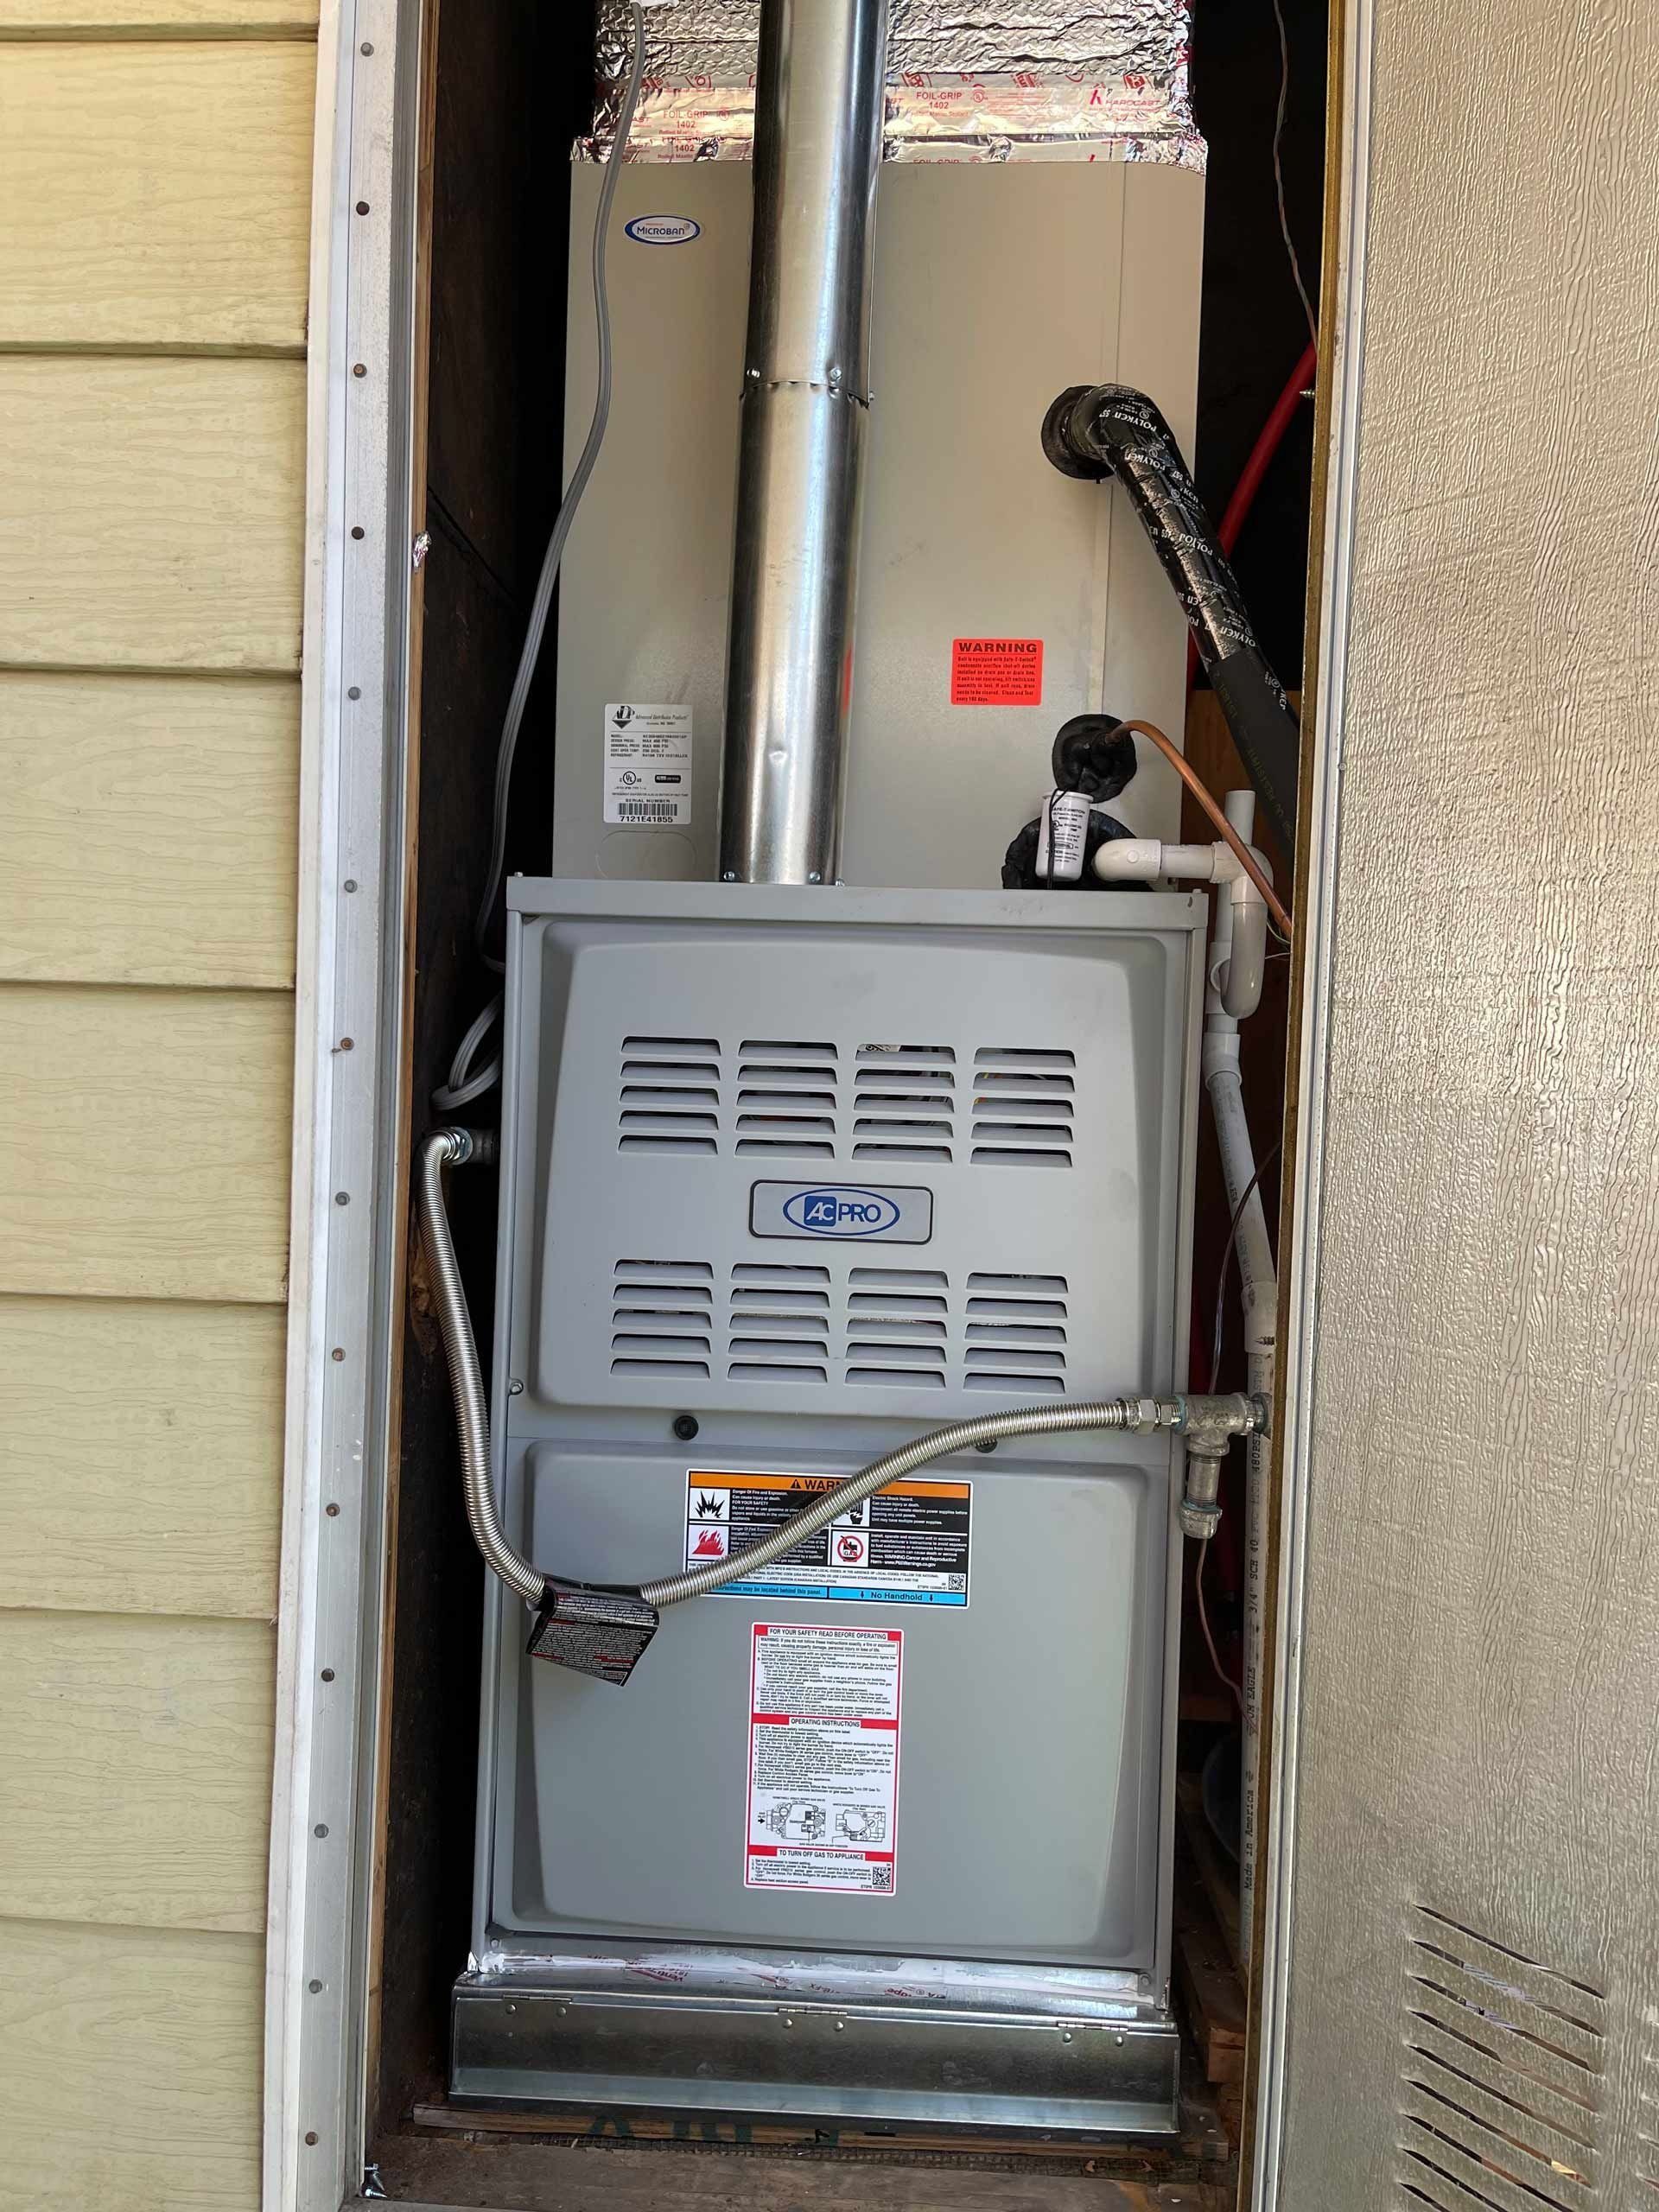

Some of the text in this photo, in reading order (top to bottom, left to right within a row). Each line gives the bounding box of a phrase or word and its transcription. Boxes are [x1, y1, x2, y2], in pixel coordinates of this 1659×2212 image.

[663, 110, 709, 119] FOIL-GRIP
[637, 226, 684, 235] MICROBAN
[1220, 626, 1255, 647] OLYKEN
[958, 642, 1037, 653] WARNING
[837, 1203, 881, 1224] PRO
[1249, 1540, 1259, 1553] 40
[1249, 1560, 1259, 1580] SCH
[870, 1591, 923, 1601] No Handhold
[1247, 1667, 1257, 1700] EAGLE
[1243, 1789, 1255, 1837] America
[1243, 1843, 1254, 1857] in
[1243, 1864, 1254, 1891] Made
